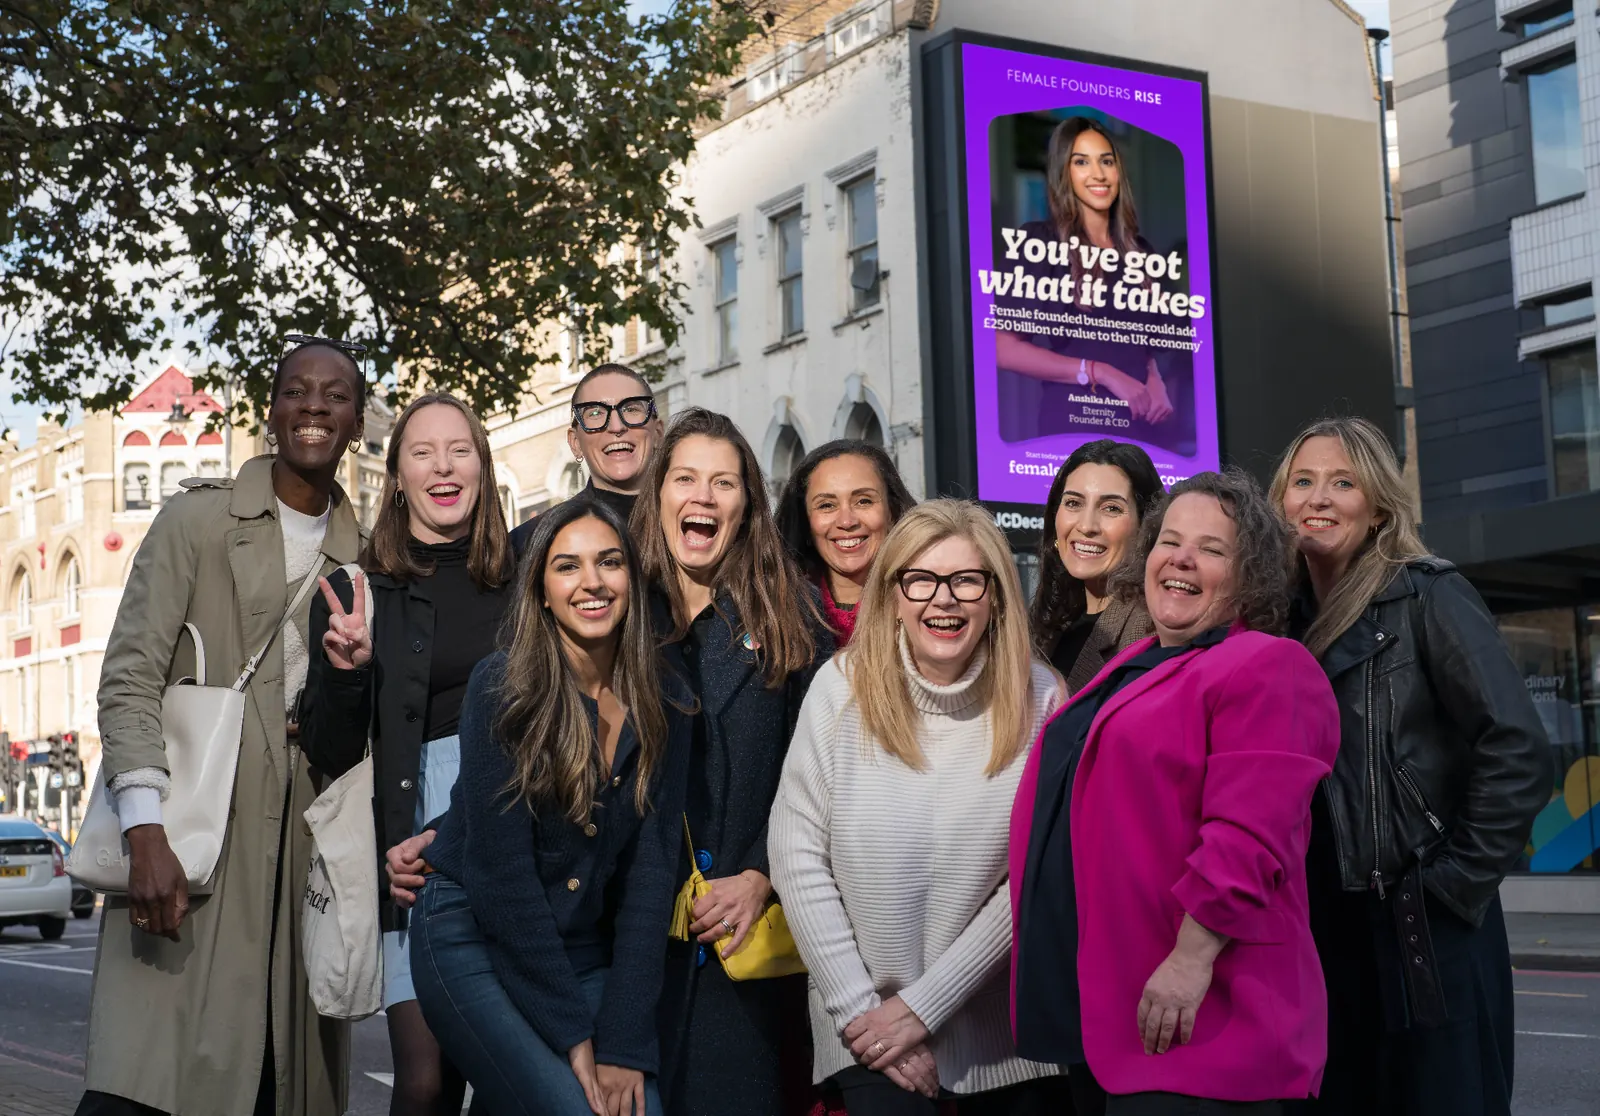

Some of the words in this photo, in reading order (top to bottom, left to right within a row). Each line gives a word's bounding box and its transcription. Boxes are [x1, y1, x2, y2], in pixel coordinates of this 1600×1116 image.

[1007, 69, 1058, 88] FEMALE
[1061, 78, 1131, 100] FOUNDERS
[1134, 90, 1162, 104] RISE
[1001, 227, 1119, 272] You've
[1122, 250, 1182, 284] got
[978, 266, 1075, 304] what
[1080, 275, 1107, 308] it
[1112, 280, 1206, 319] takes
[989, 304, 1032, 319] Female
[1033, 309, 1082, 325] founded
[1083, 315, 1144, 332] businesses
[1144, 323, 1175, 335] could
[1176, 326, 1197, 338] add
[983, 317, 1012, 331] £250
[1013, 320, 1051, 335] billion
[1052, 325, 1064, 337] of
[1065, 327, 1096, 340] value
[1097, 329, 1110, 342] to
[1110, 331, 1130, 344] the
[1130, 333, 1149, 346] UK
[1068, 393, 1104, 405] Anshika
[1104, 396, 1129, 407] Arora
[1068, 413, 1104, 426] Founder
[1104, 417, 1112, 427] &
[1112, 418, 1130, 428] CEO
[1082, 405, 1116, 419] Eternity
[1009, 459, 1061, 477] female
[993, 511, 1045, 530] JCDeca
[1523, 674, 1566, 690] dinary
